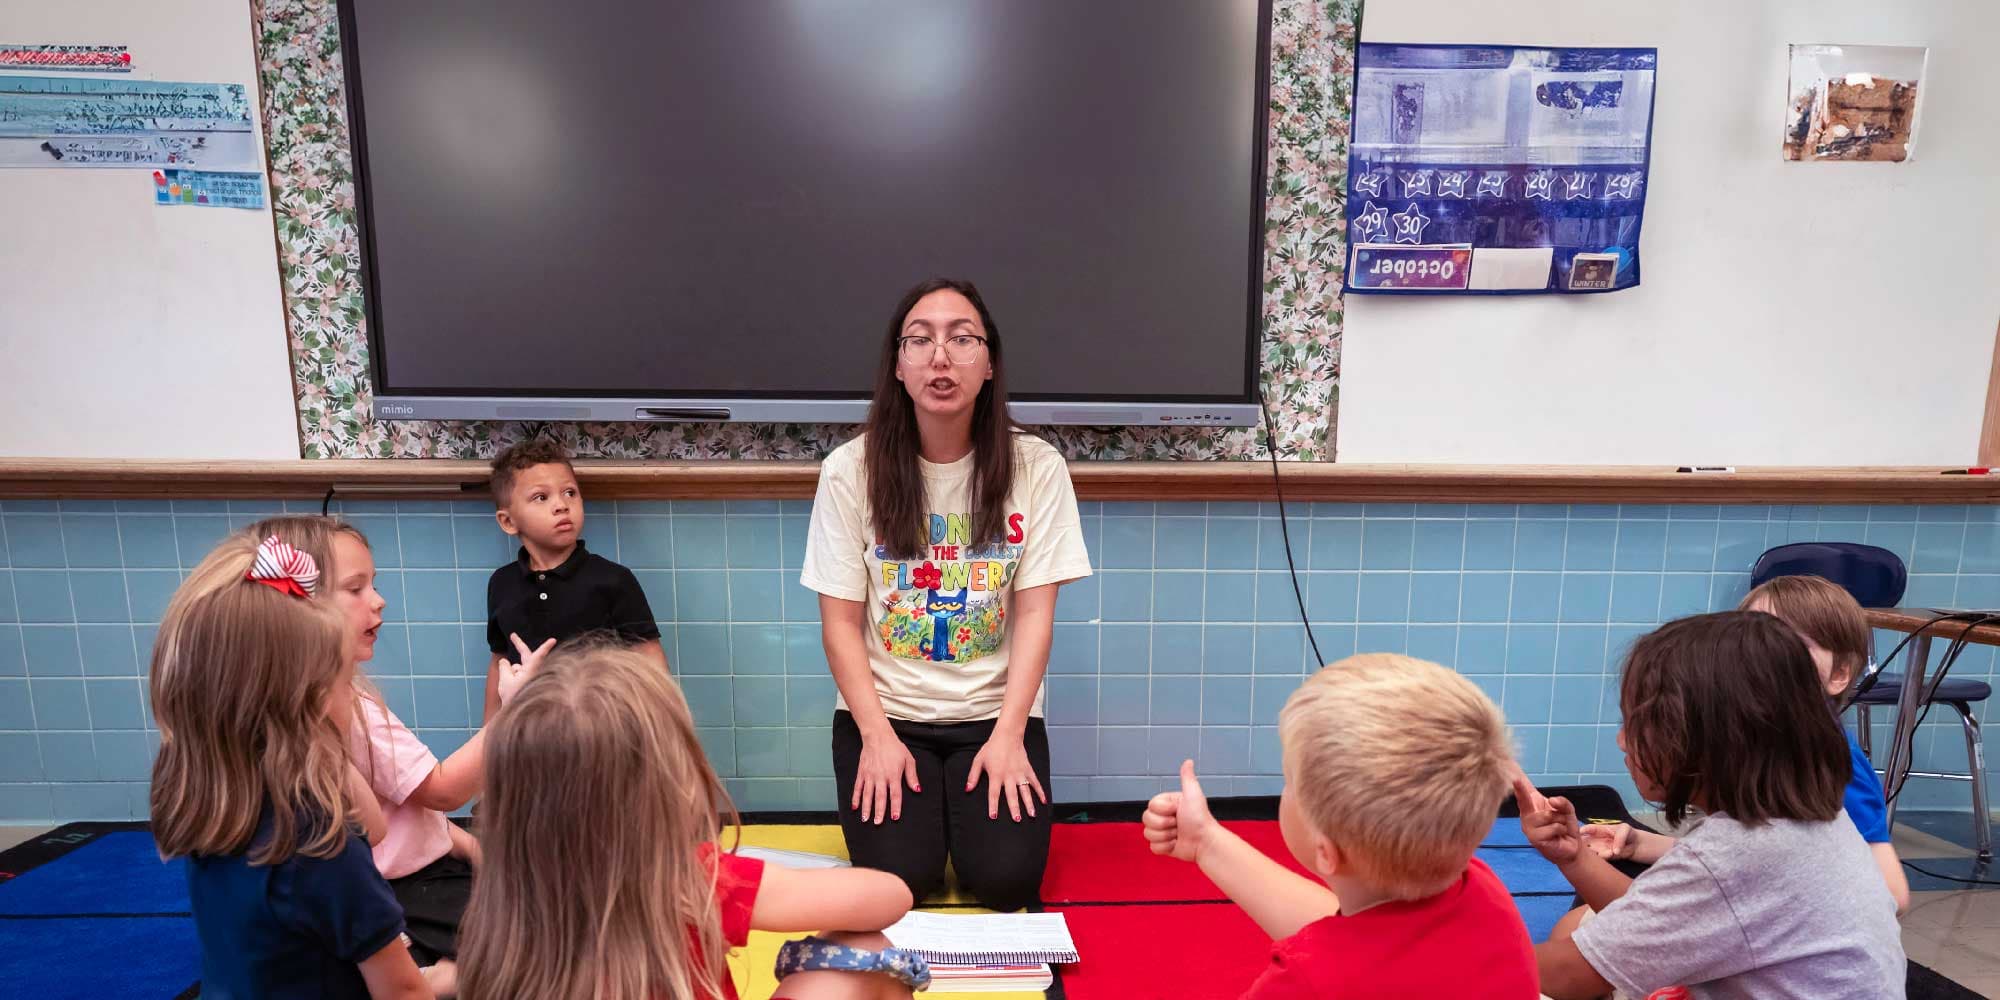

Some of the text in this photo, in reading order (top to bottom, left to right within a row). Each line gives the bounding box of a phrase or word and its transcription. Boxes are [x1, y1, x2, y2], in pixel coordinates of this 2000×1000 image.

[1363, 212, 1421, 235] 29 30
[1369, 258, 1454, 280] October
[1574, 279, 1607, 288] WINTER
[381, 404, 414, 414] mimio
[932, 545, 960, 561] THE
